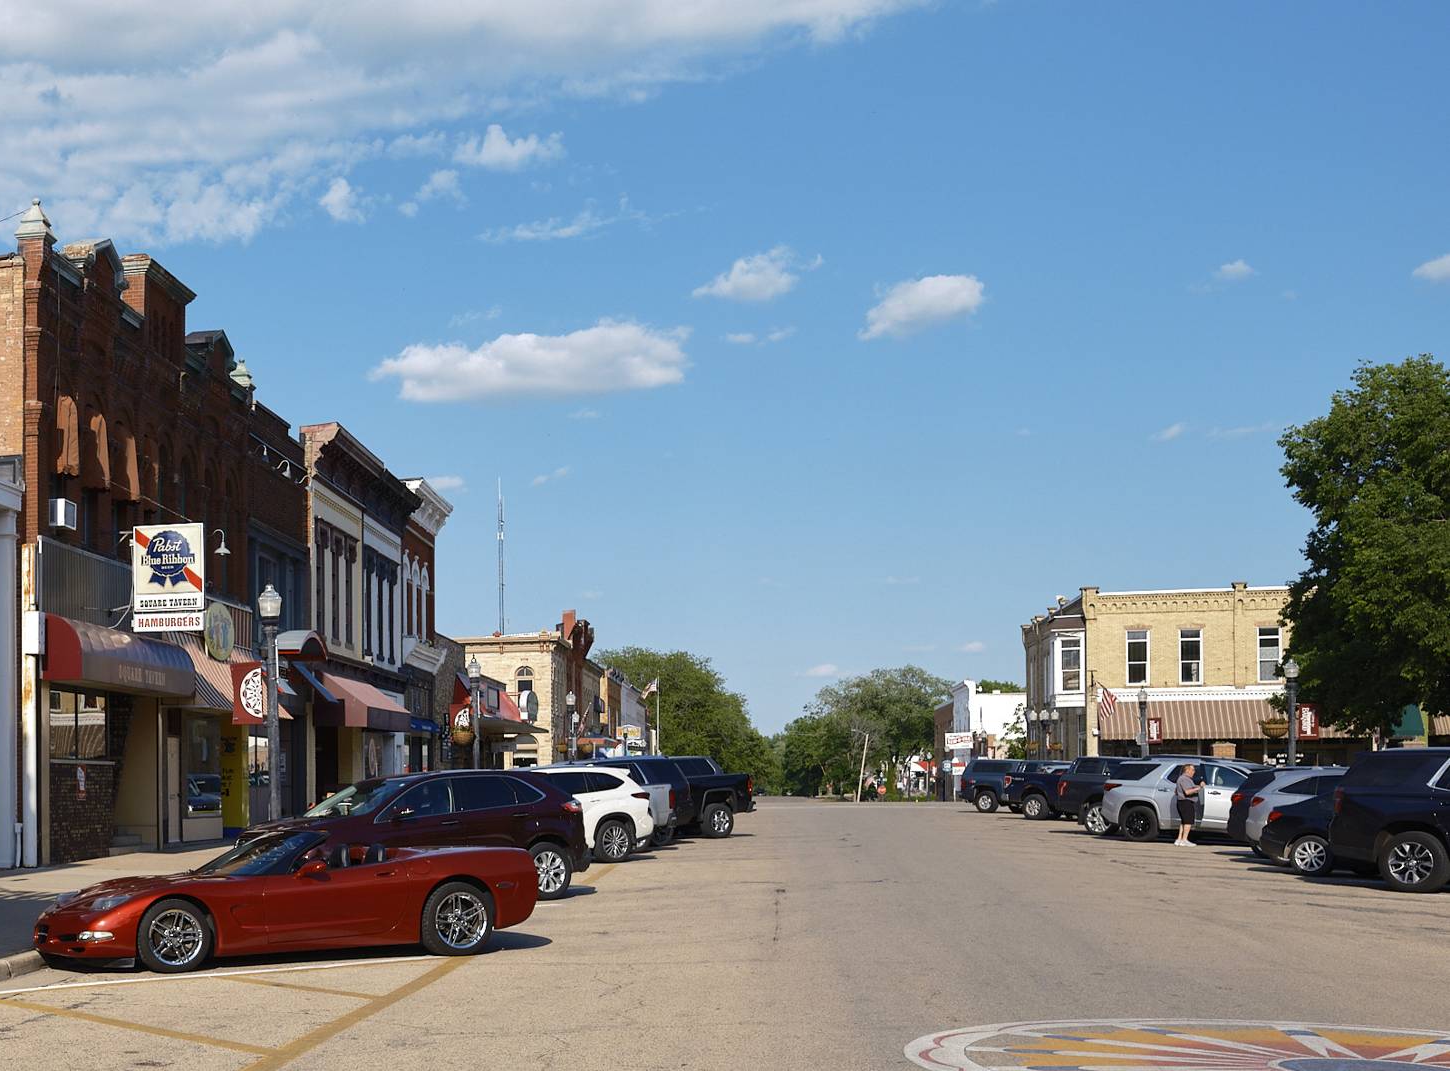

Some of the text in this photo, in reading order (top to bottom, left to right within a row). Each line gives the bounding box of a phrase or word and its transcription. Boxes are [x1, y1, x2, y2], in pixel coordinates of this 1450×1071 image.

[152, 537, 183, 553] Pabst
[142, 553, 195, 566] Blue Ribbon
[140, 598, 198, 608] SQUARE TAVERN
[138, 616, 201, 628] HAMBURGERS
